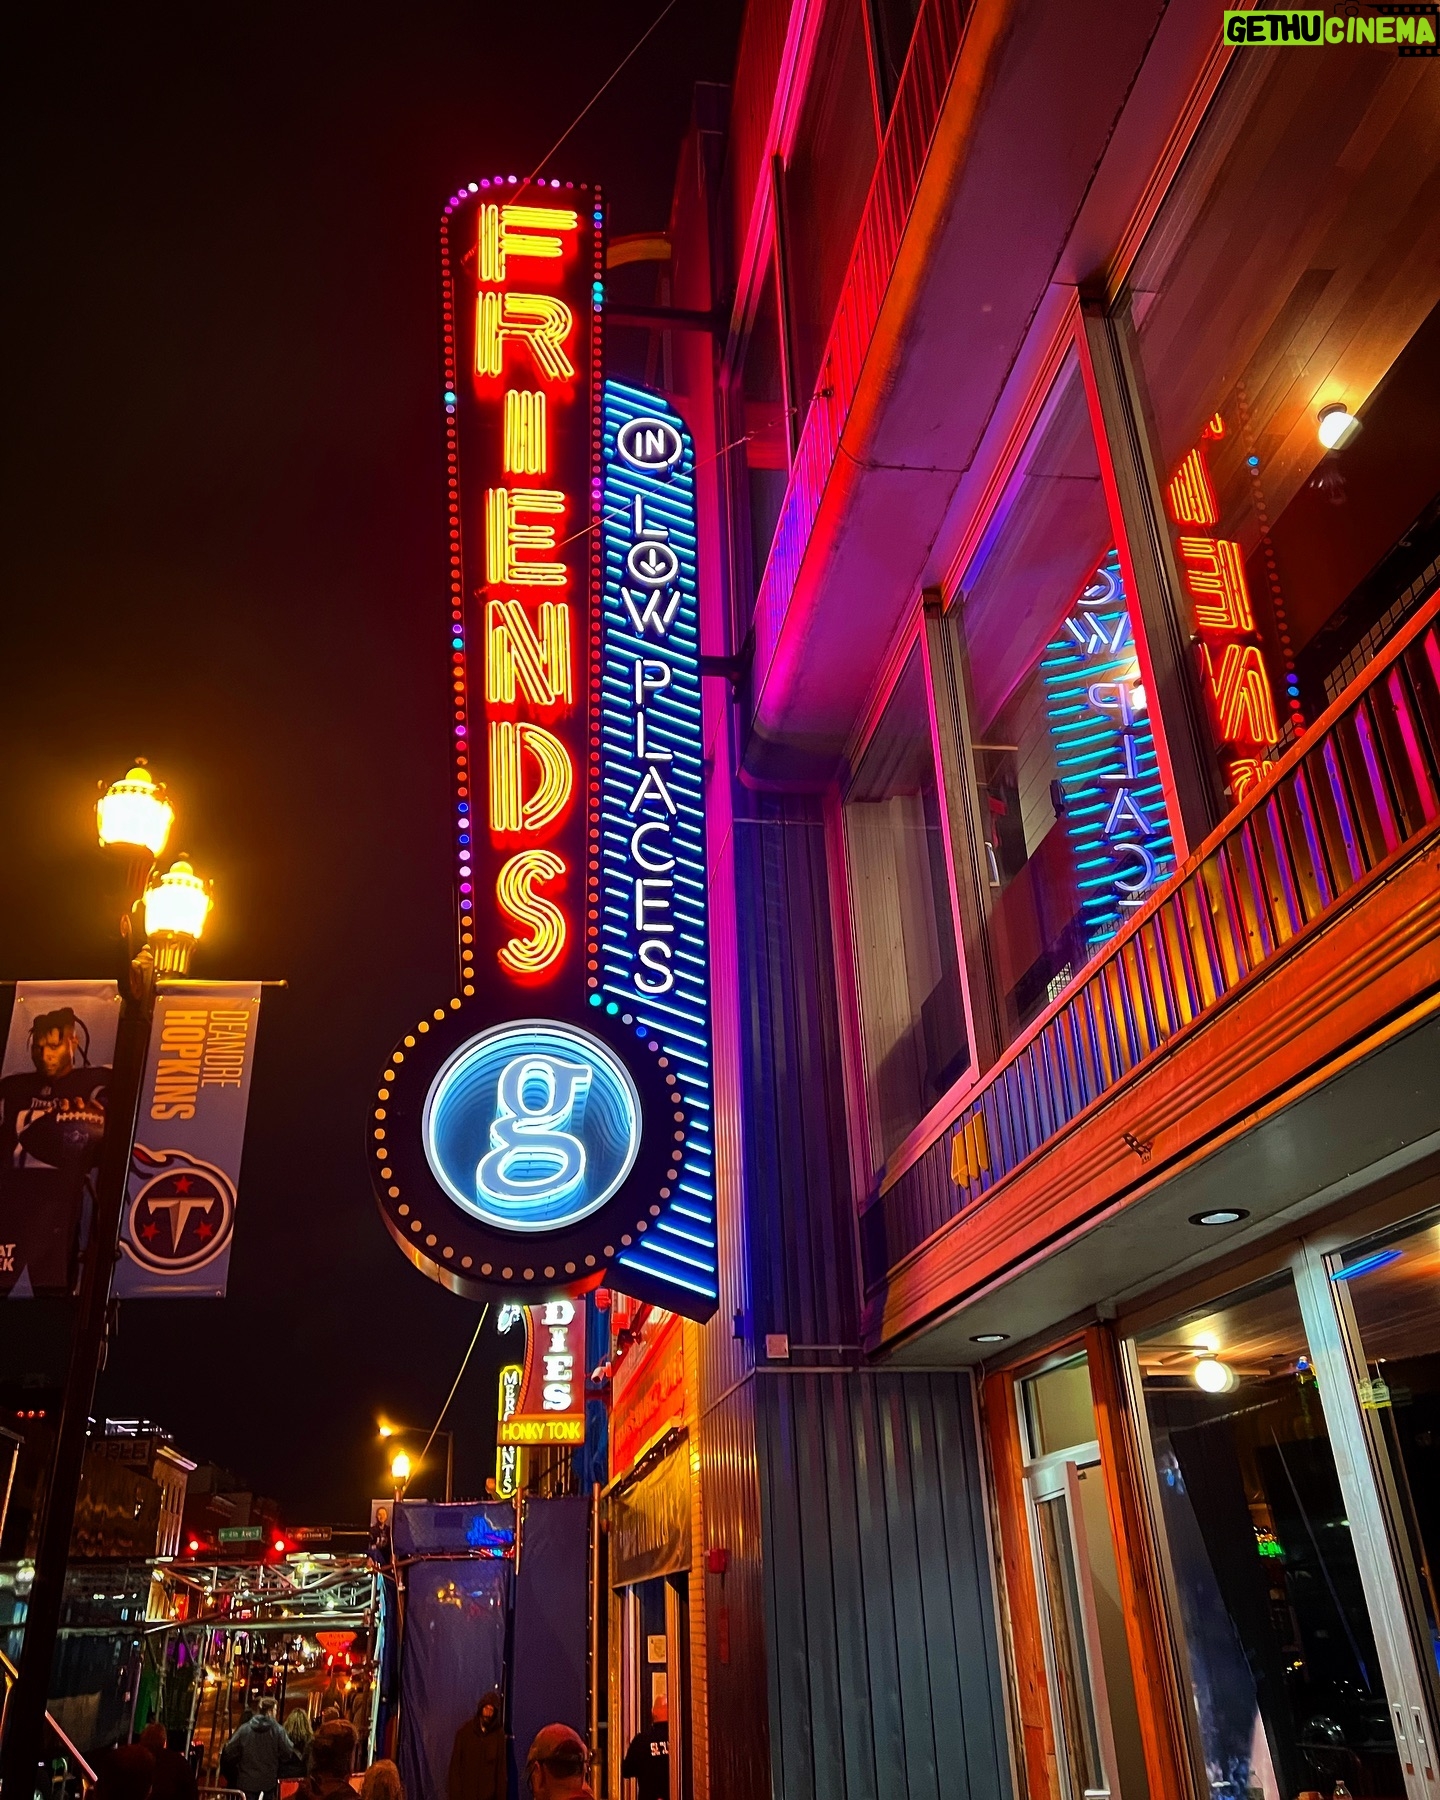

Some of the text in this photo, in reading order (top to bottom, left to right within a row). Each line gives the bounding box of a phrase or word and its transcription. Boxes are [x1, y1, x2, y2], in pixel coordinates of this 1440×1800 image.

[474, 203, 578, 974] FRIENDS
[621, 428, 681, 994] IN LOW PLACES
[150, 1010, 208, 1120] HOPKINS
[201, 1010, 250, 1088] DEANDRE
[501, 1371, 519, 1493] MERCNTS
[502, 1421, 581, 1441] HONKY TONK
